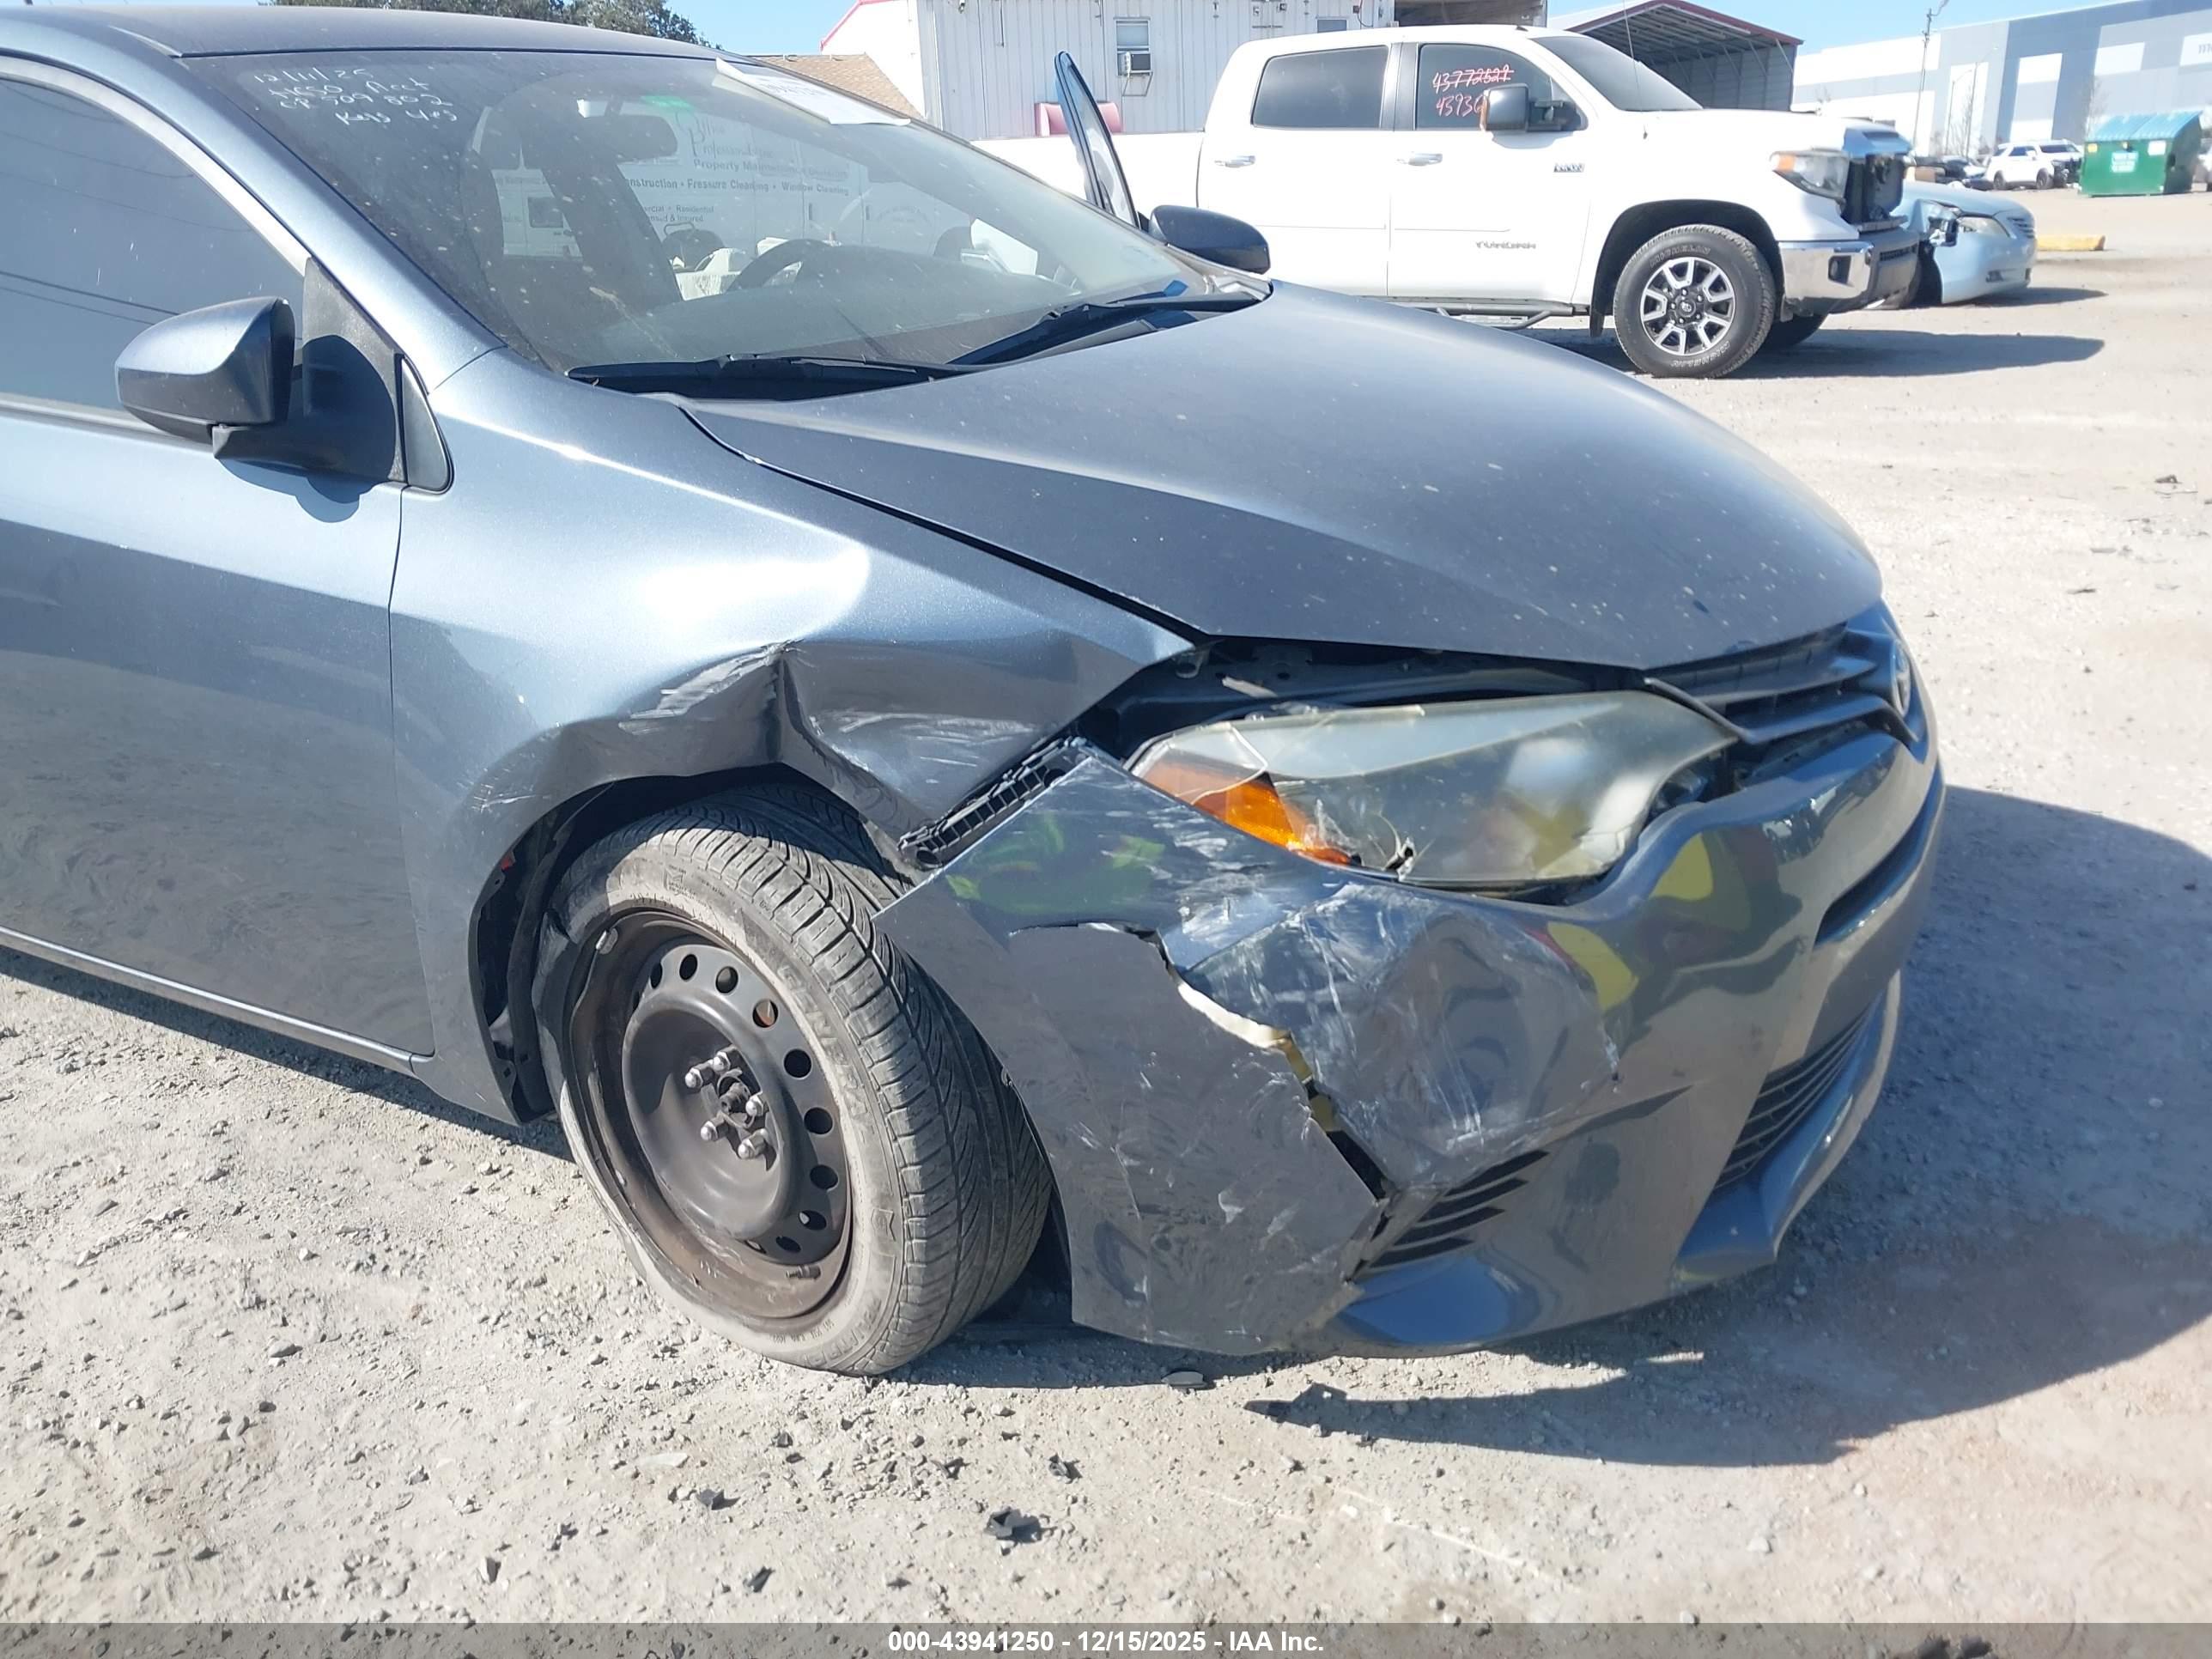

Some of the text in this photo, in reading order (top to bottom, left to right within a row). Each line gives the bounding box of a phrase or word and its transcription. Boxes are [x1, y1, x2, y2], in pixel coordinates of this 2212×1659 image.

[694, 159, 740, 173] Property
[629, 178, 678, 190] nstruction
[730, 179, 769, 193] Cleaning
[781, 181, 814, 192] Window
[816, 183, 849, 197] Cleaning
